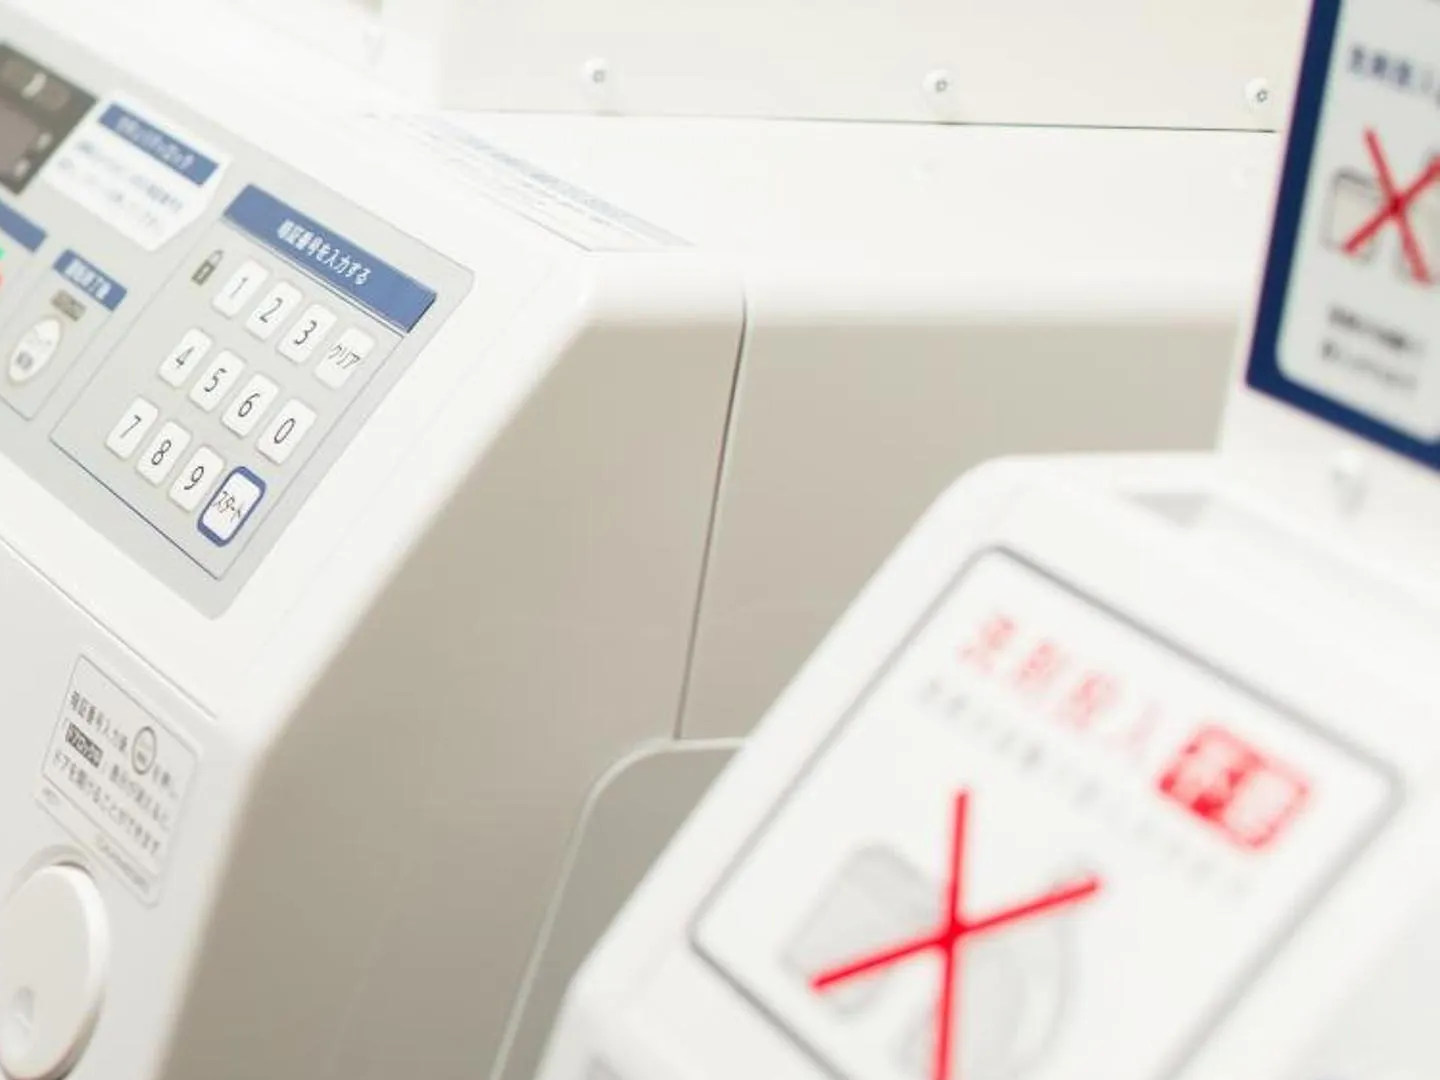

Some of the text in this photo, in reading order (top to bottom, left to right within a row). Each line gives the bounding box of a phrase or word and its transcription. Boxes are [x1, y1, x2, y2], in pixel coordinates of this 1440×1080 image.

[228, 276, 361, 370] 1 2 3 クリア
[174, 346, 296, 445] 4 5 6 0
[120, 414, 242, 522] 7 8 9 スタート
